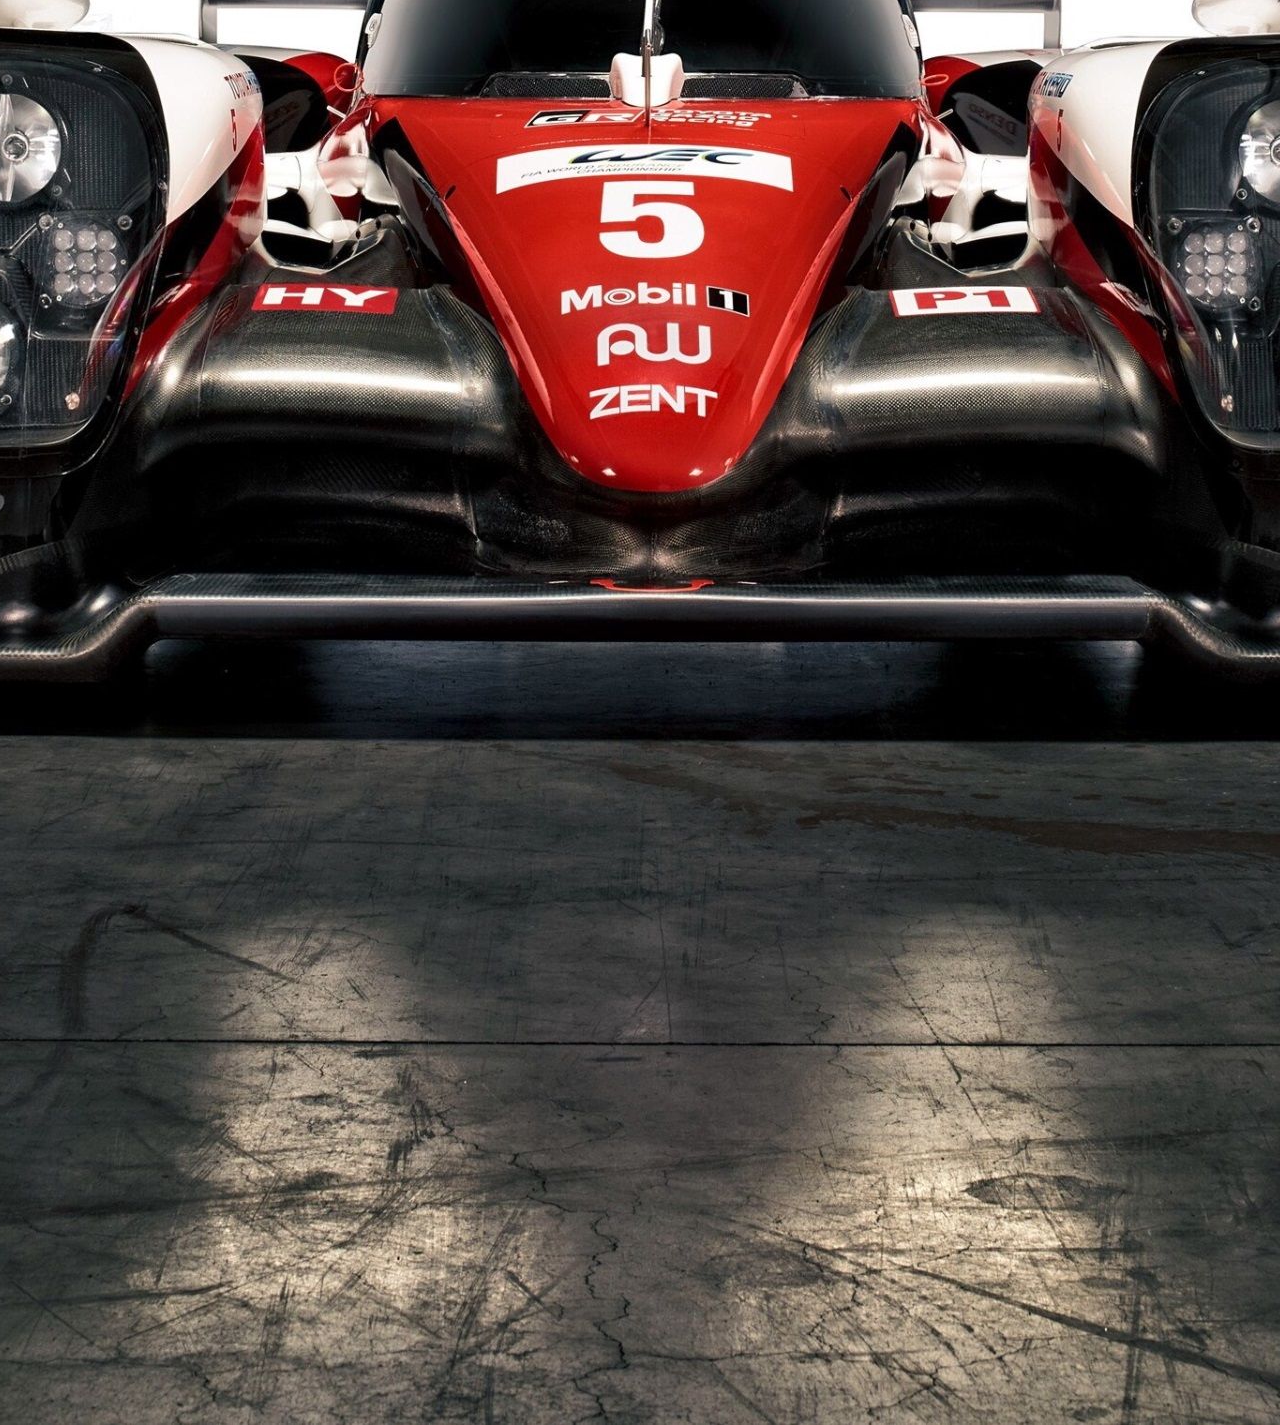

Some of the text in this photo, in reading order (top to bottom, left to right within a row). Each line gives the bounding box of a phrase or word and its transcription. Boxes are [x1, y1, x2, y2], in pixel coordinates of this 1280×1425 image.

[230, 108, 238, 152] 5
[532, 112, 636, 124] GR
[1056, 108, 1065, 152] 5
[520, 170, 543, 179] FIA
[547, 164, 595, 174] WORLD
[598, 180, 706, 259] 5
[262, 286, 391, 307] HY
[561, 281, 697, 315] Mobil
[913, 289, 1012, 310] P1
[589, 384, 719, 420] ZENT
